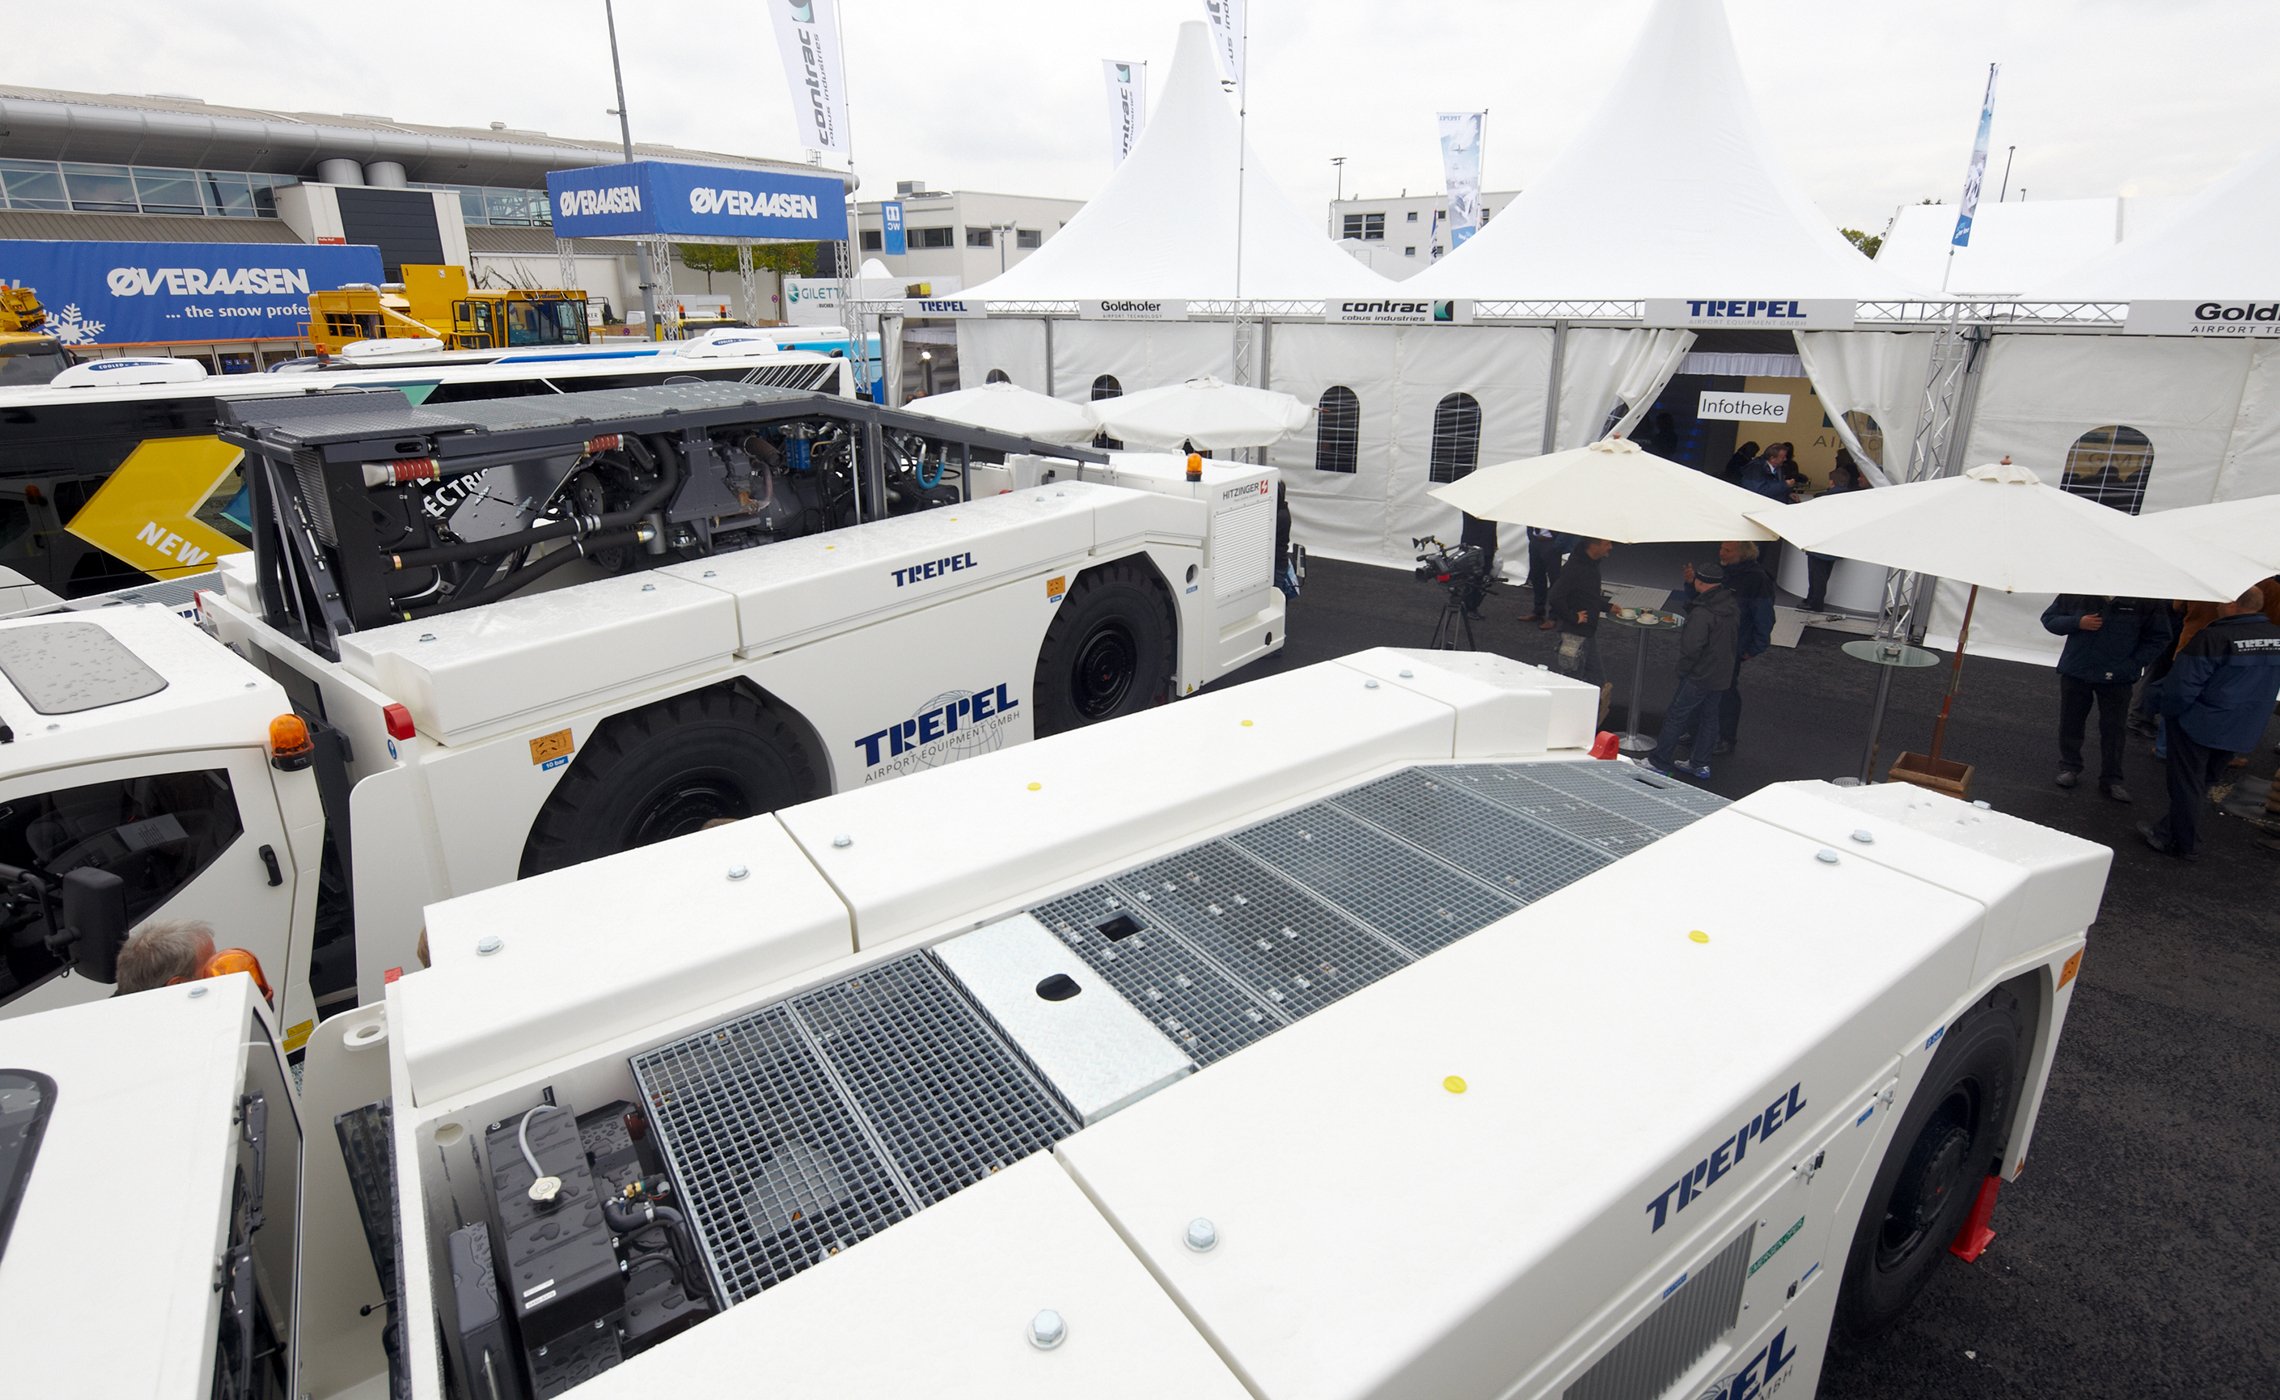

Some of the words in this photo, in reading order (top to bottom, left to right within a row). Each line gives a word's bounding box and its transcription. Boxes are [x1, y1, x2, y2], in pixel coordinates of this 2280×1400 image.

[814, 33, 830, 101] industries
[798, 28, 829, 146] contrac
[1120, 87, 1130, 160] ontrac
[560, 185, 642, 217] ØVERAASEN
[690, 187, 818, 220] ØVERAASEN
[107, 266, 310, 297] ØVERAASEN
[185, 305, 213, 318] the
[219, 307, 262, 317] snow
[919, 301, 967, 311] TREPEL
[1101, 301, 1161, 311] Goldhofer
[1342, 300, 1428, 313] contrac
[1687, 300, 1807, 318] TREPEL
[2195, 303, 2280, 321] Gold
[2190, 325, 2256, 334] AIRPORT
[1703, 399, 1784, 416] Infotheke
[1223, 482, 1260, 500] HITZINGER
[136, 521, 210, 568] NEW
[891, 552, 978, 587] TREPEL
[2234, 639, 2280, 648] TREPE
[855, 683, 1019, 767] TREPEL
[864, 753, 918, 783] AIRPORT
[921, 725, 986, 760] EQUIPMENT
[989, 711, 1021, 729] GMBH
[1646, 1082, 1807, 1234] TREPEL
[1714, 1326, 1797, 1400] EL
